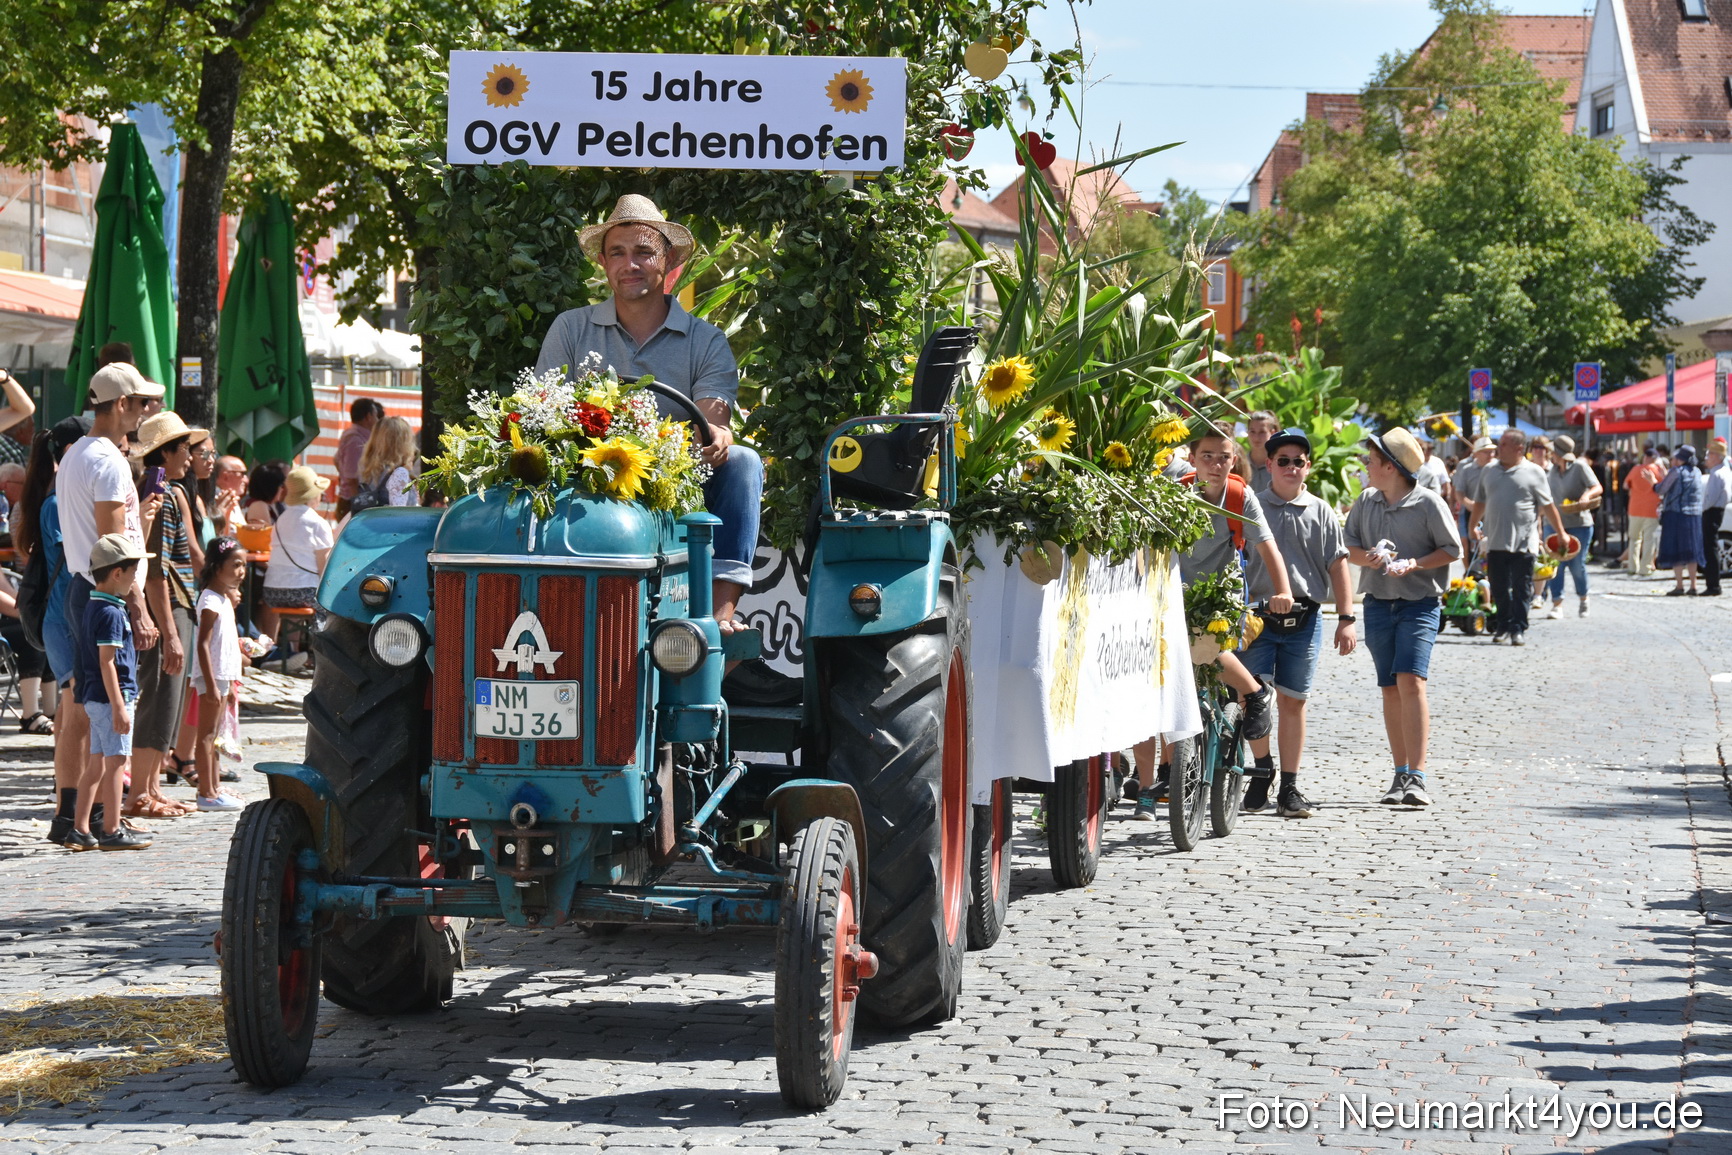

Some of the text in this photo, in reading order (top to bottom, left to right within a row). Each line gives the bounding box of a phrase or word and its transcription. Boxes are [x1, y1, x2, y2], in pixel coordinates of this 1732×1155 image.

[590, 69, 763, 103] 15 Jahre
[464, 119, 888, 162] OGV Pelchenhofen
[1576, 388, 1598, 400] TAXI
[481, 695, 488, 704] D
[495, 685, 528, 709] NM
[492, 711, 562, 736] JJ 36
